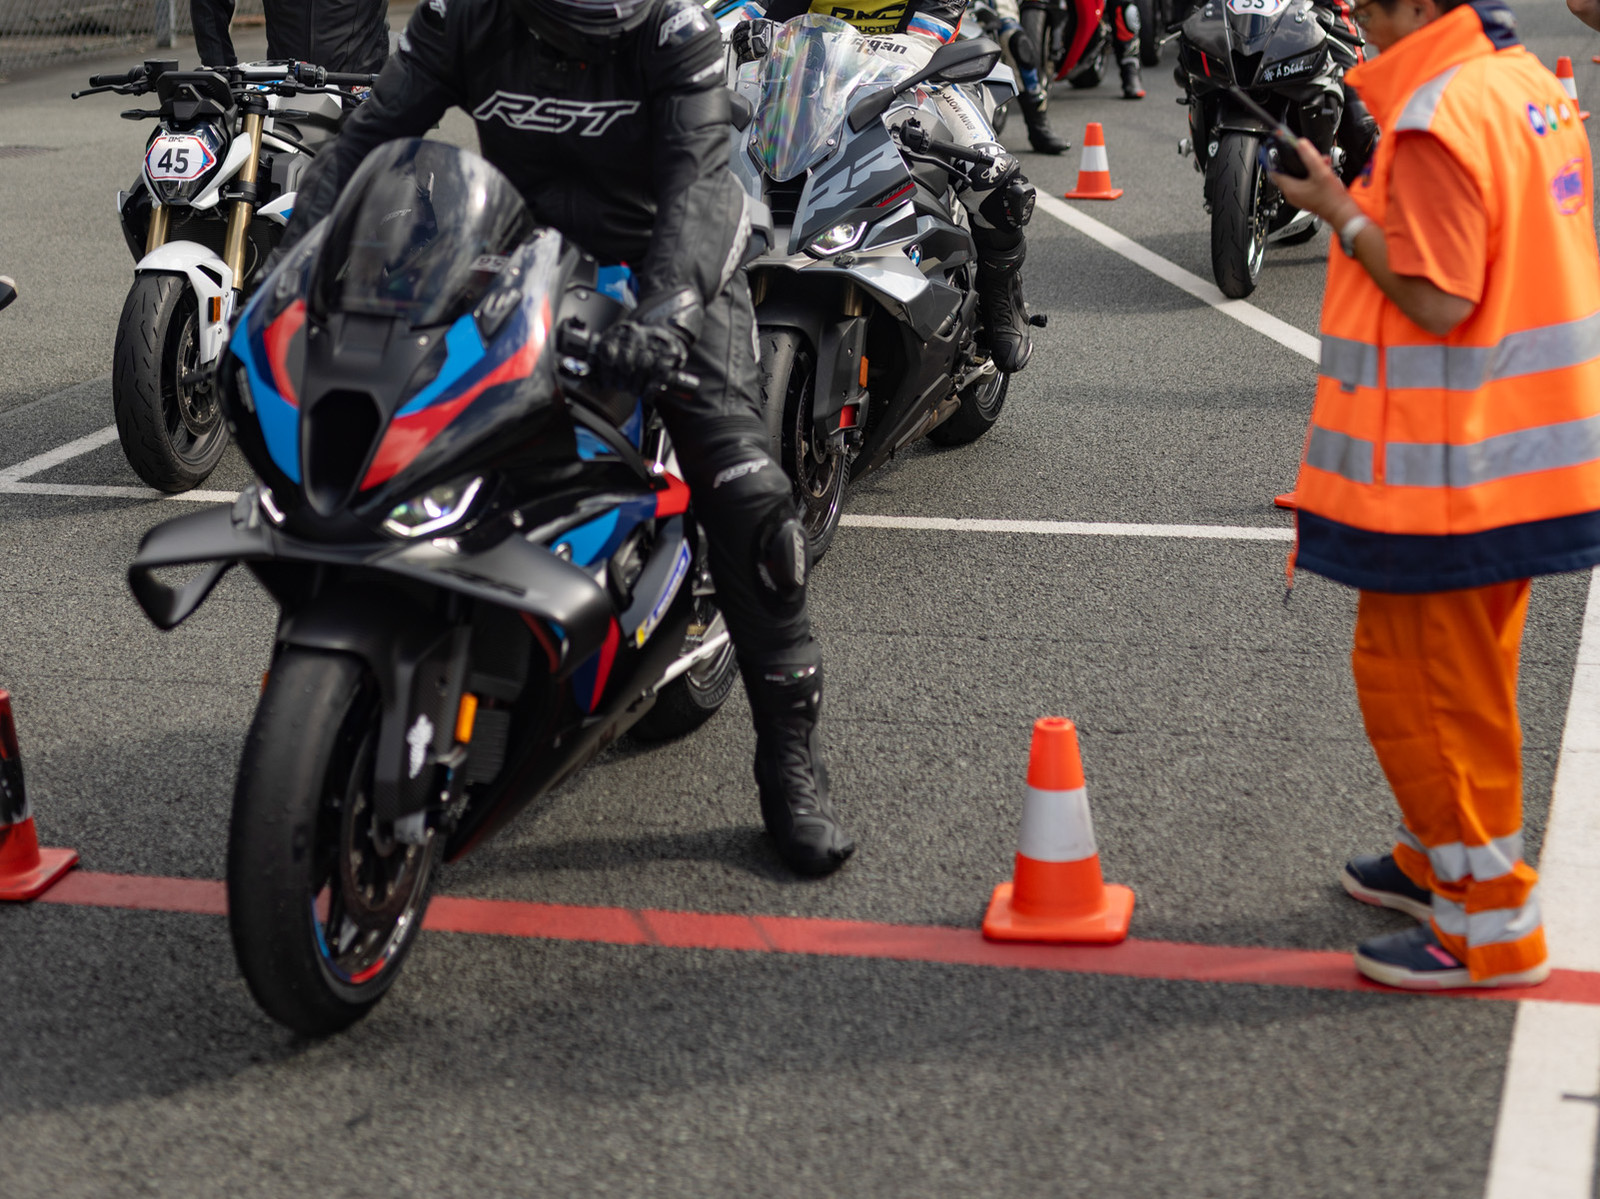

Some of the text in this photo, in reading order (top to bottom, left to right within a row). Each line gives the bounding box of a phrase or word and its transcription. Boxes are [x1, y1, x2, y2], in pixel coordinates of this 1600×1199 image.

[472, 89, 641, 138] RST
[157, 147, 190, 174] 45
[802, 139, 903, 225] RR
